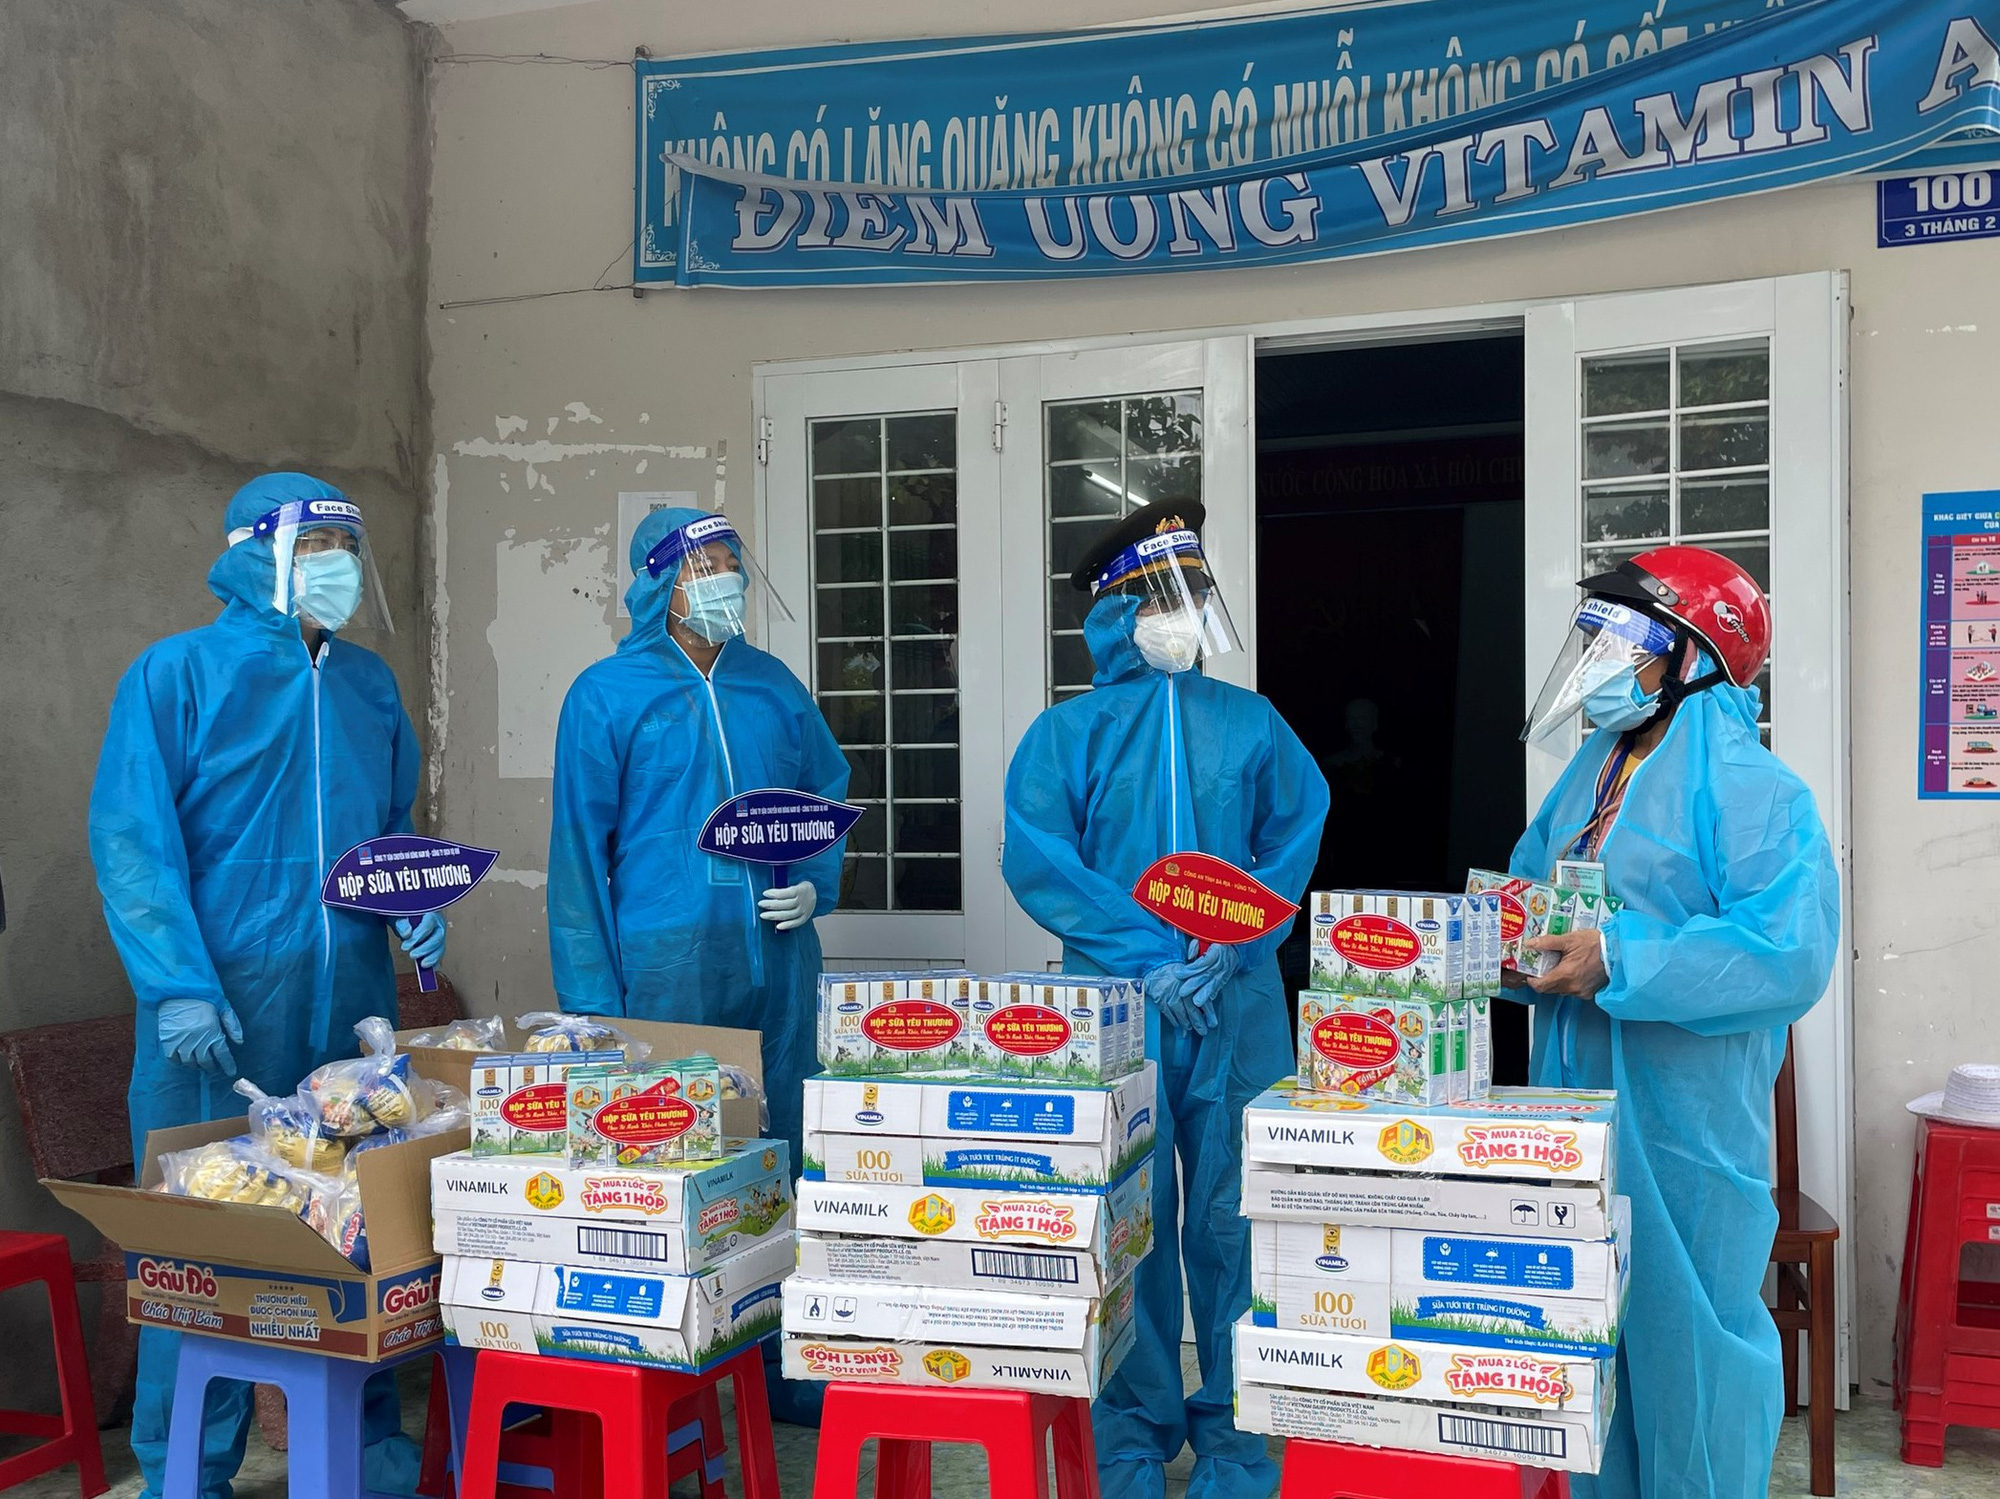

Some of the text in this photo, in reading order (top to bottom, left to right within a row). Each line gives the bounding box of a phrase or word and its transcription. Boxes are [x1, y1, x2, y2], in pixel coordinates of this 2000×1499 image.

[942, 95, 1059, 191] QUĂNG
[1068, 75, 1197, 185] KHÔNG
[1206, 62, 1258, 171] CÓ
[1271, 28, 1371, 159] MUỖI
[1354, 31, 1878, 227] VITAMIN
[1917, 16, 2000, 116] A
[1908, 172, 1992, 213] 100
[1905, 215, 1996, 237] 3 THÁNG 2
[317, 504, 343, 512] Face
[692, 524, 712, 534] Face
[1143, 539, 1170, 552] Face
[1172, 533, 1198, 543] Shield
[1587, 602, 1621, 619] shield
[715, 820, 835, 849] HỘP SỮA YÊU THƯƠNG
[338, 864, 471, 901] HỘP SỮA YÊU THƯƠNG
[1148, 878, 1266, 929] HỘP SỮA YÊU THƯƠNG
[1268, 1126, 1354, 1145] VINAMILK
[1491, 1126, 1550, 1143] MUA 2 LỐC
[1462, 1142, 1578, 1166] TẶNG 1 HỘP
[602, 1177, 645, 1190] MUA 2 LỐC
[846, 1171, 903, 1182] SỮA TƯƠI
[446, 1180, 508, 1194] VINAMILK
[584, 1190, 665, 1210] TẶNG 1 HỘP
[814, 1200, 889, 1217] VINAMILK
[1003, 1204, 1025, 1212] MUA
[1033, 1200, 1052, 1215] LỐC
[979, 1215, 1073, 1238] TẶNG 1 HỘP
[1317, 1259, 1347, 1267] VINAMILK
[138, 1258, 219, 1299] Gấu Đỏ
[256, 1293, 308, 1308] THƯƠNG HIỆU
[384, 1280, 431, 1316] Gấu
[141, 1299, 169, 1319] Cháo
[275, 1308, 300, 1320] CHỌN
[300, 1309, 318, 1319] MUA
[251, 1320, 320, 1340] NHIỀU NHẤT
[1301, 1313, 1367, 1330] SỮA TƯƠI
[474, 1336, 522, 1351] SỮA TƯƠI
[1258, 1347, 1343, 1369] VINAMILK
[1478, 1356, 1537, 1372] MUA 2 LỐC
[992, 1365, 1071, 1381] VINAMILK
[1450, 1370, 1564, 1397] TẶNG 1 HỘP
